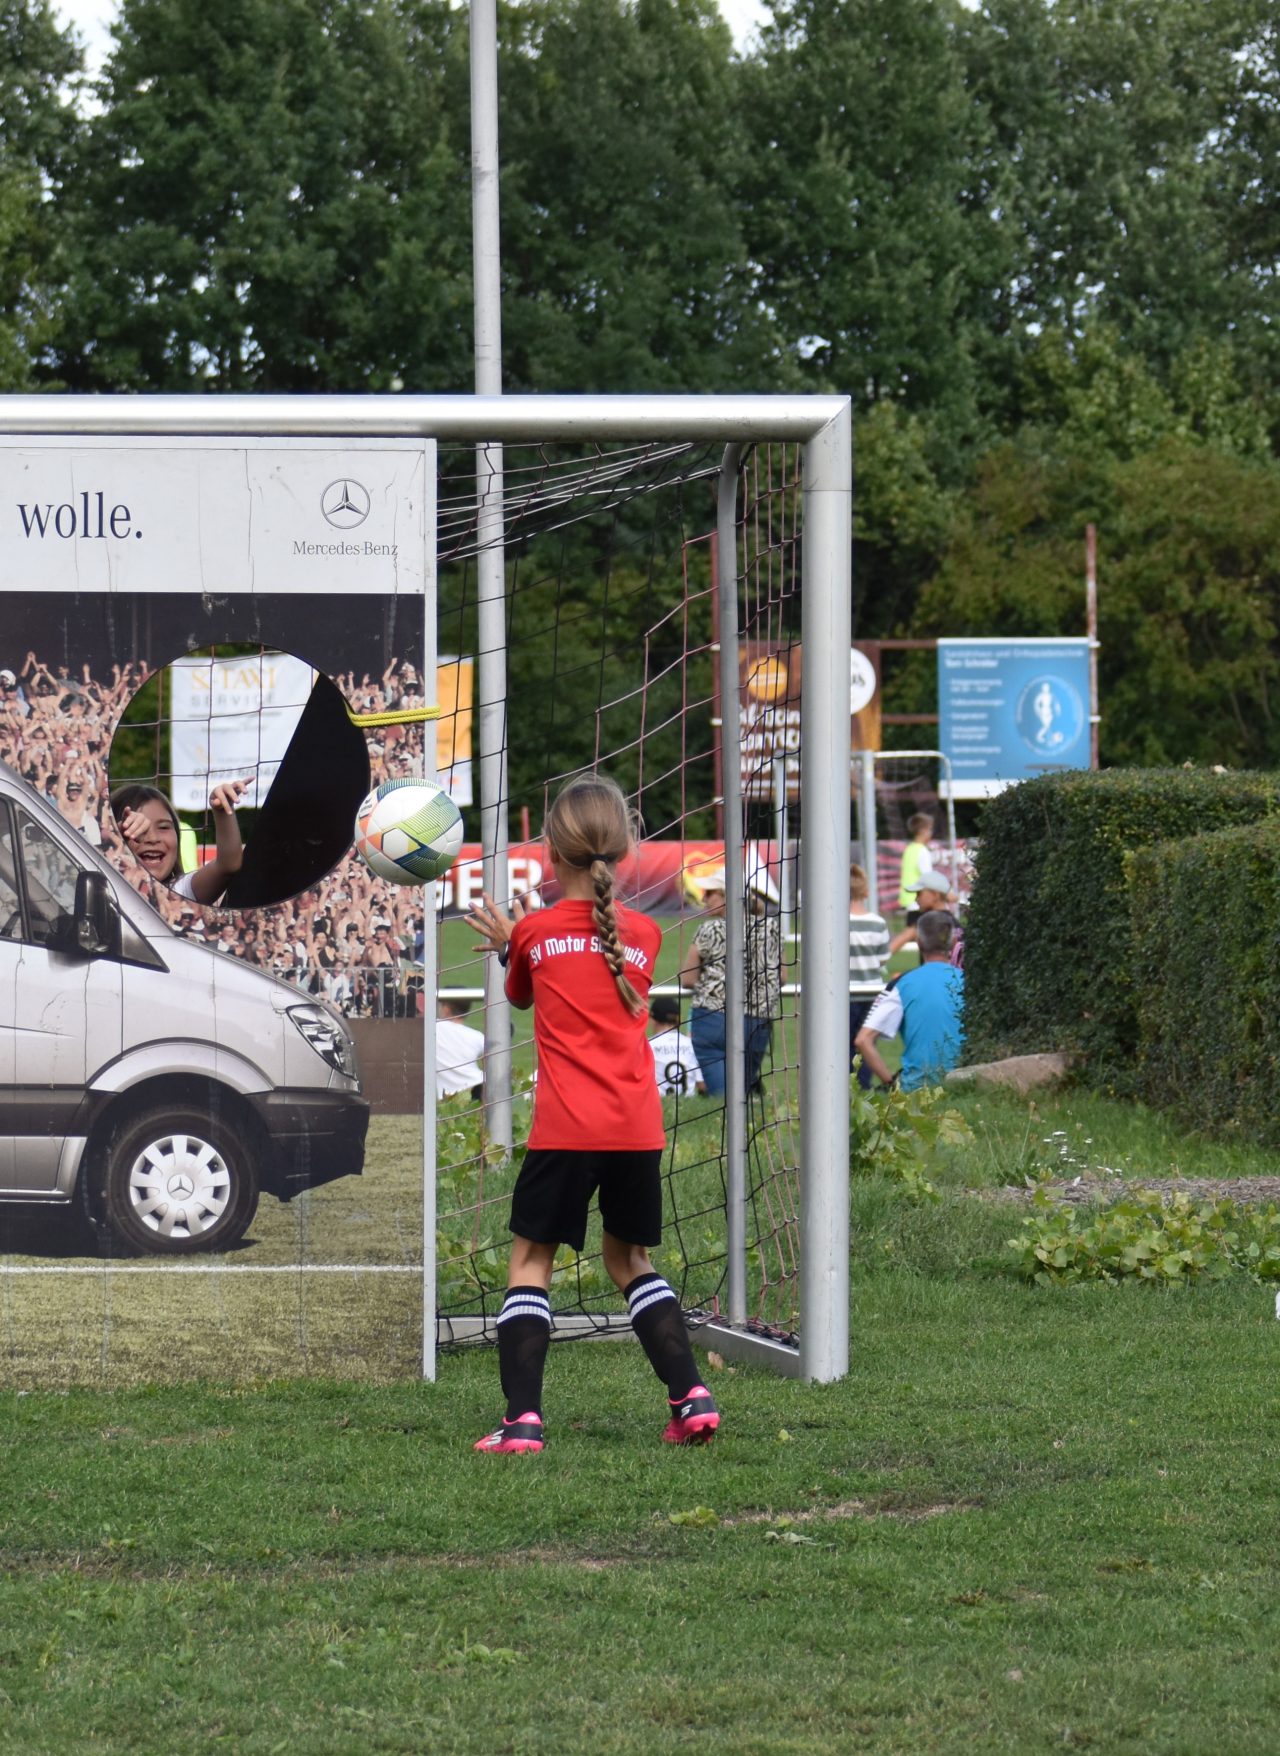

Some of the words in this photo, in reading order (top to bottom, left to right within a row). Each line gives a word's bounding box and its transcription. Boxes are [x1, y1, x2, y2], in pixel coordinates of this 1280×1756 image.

[16, 492, 144, 540] wolle.
[293, 540, 398, 556] Mercedes-Benz
[530, 944, 542, 965] SV
[545, 935, 586, 957] Motor
[664, 1061, 688, 1096] 9
